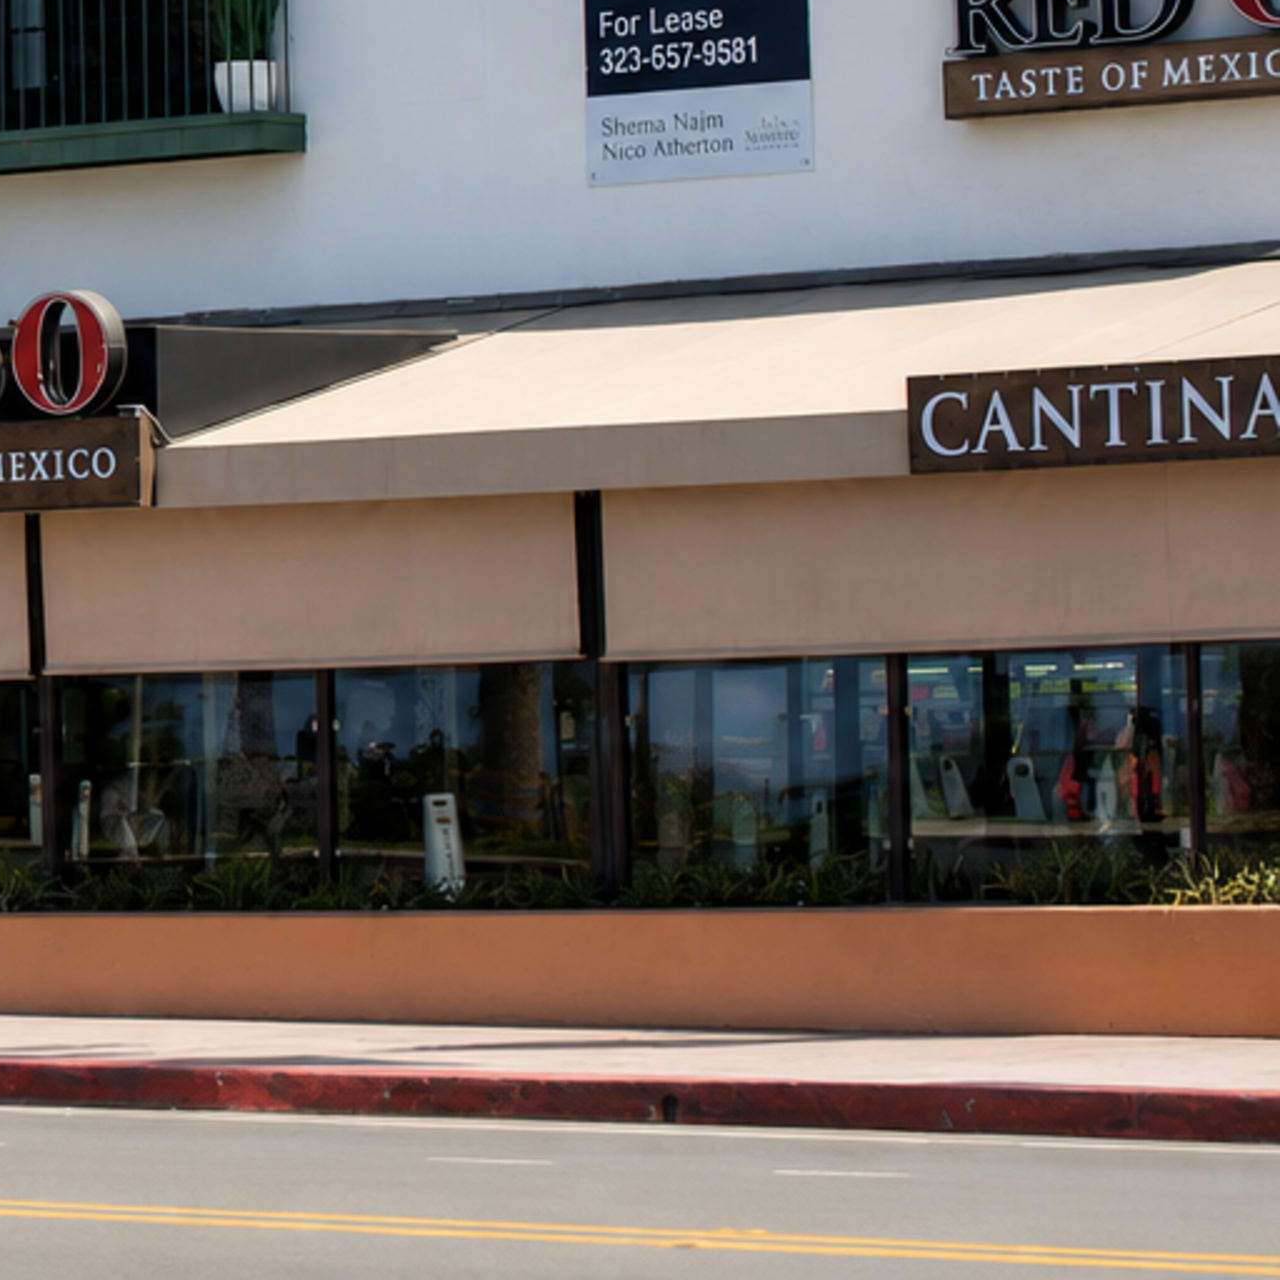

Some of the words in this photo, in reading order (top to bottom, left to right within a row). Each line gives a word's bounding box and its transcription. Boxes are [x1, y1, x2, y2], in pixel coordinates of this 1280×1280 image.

[599, 10, 641, 38] For
[649, 7, 724, 35] Lease
[599, 36, 759, 74] 323-657-9581
[970, 65, 1085, 101] TASTE
[1101, 60, 1149, 92] OF
[602, 141, 646, 161] Nico
[653, 134, 734, 159] Atherton
[12, 289, 128, 417] O
[920, 372, 1280, 457] CANTINA
